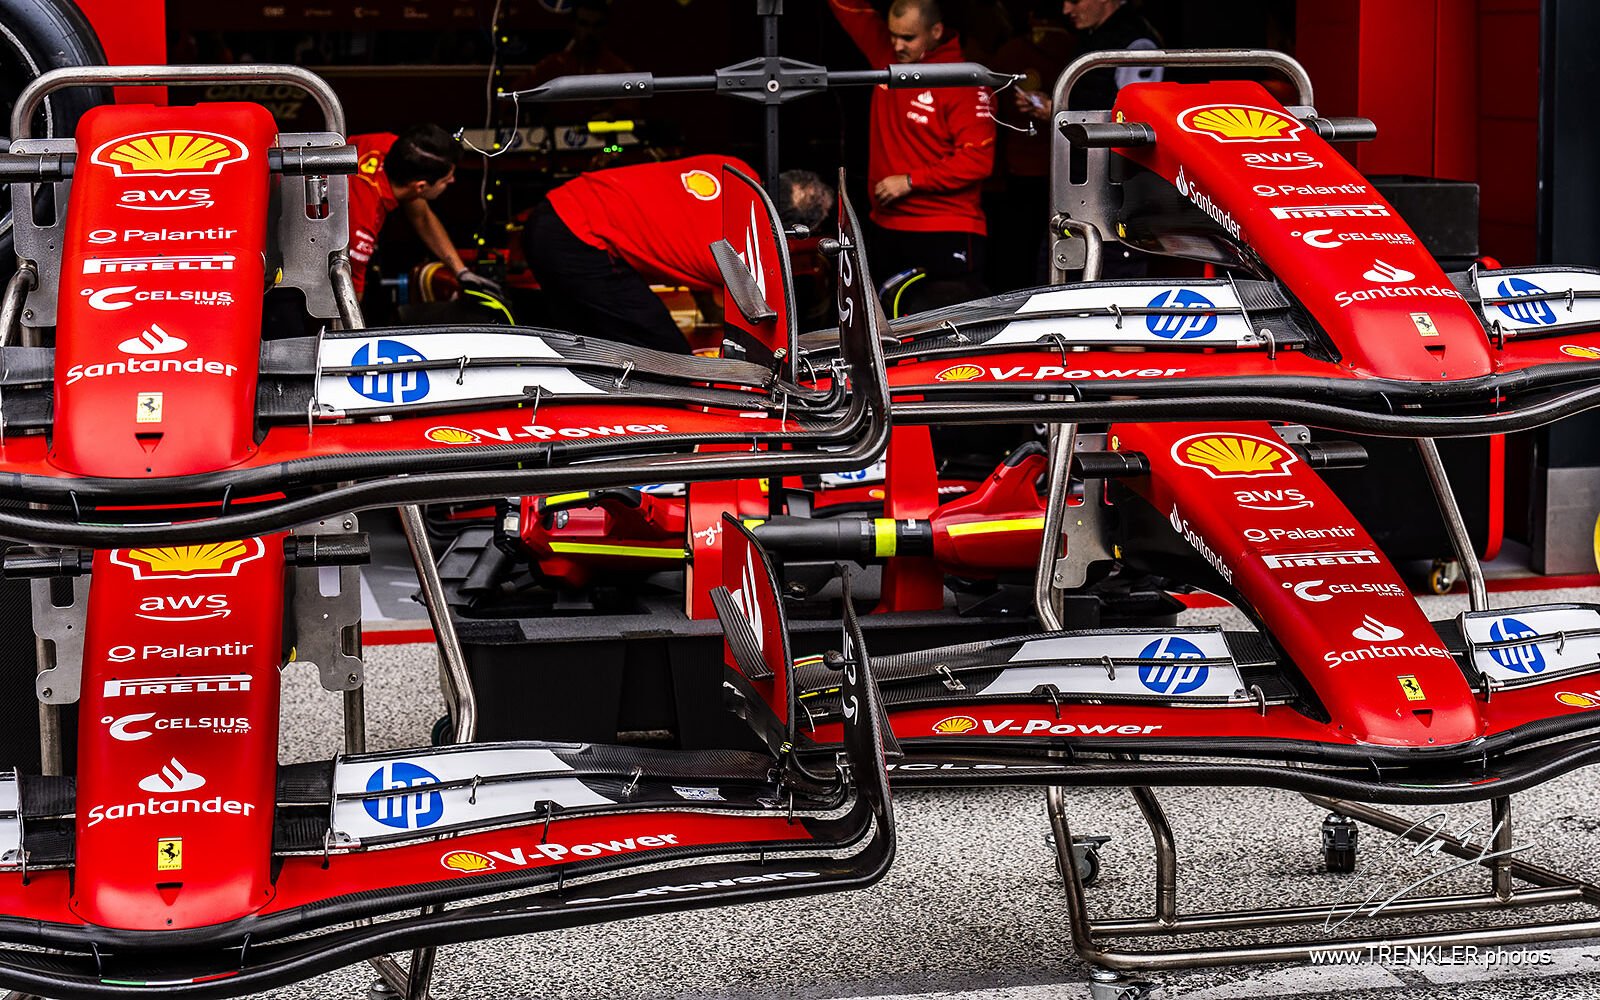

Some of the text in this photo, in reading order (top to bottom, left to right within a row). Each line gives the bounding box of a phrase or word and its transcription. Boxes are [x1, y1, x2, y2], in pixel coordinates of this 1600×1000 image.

[1242, 152, 1314, 164] aws
[120, 189, 212, 202] aws
[1283, 183, 1366, 195] Palantir
[1189, 181, 1241, 241] Santander
[1269, 203, 1391, 220] PIRELLI
[124, 227, 237, 241] Palantir
[1337, 232, 1413, 241] CELSIUS
[83, 255, 236, 275] PIRELLI
[135, 290, 231, 301] CELSIUS
[1335, 284, 1462, 308] Santander
[1503, 278, 1547, 325] hp
[1153, 289, 1211, 339] hp
[66, 357, 238, 386] Santander
[362, 340, 422, 403] hp
[989, 366, 1186, 381] V-Power
[475, 422, 669, 442] V-Power
[1234, 488, 1306, 502] aws
[1269, 526, 1356, 541] Palantir
[1183, 519, 1232, 585] Santander
[1262, 550, 1381, 570] PIRELLI
[1328, 583, 1402, 593] CELSIUS
[139, 594, 229, 610] aws
[142, 641, 254, 660] Palantir
[1324, 643, 1450, 668] Santander
[1496, 618, 1536, 673] hp
[1145, 636, 1202, 694] hp
[103, 674, 253, 697] PIRELLI
[155, 717, 250, 729] CELSIUS
[982, 719, 1163, 735] V-Power
[378, 763, 436, 829] hp
[88, 796, 255, 827] Santander
[490, 831, 679, 866] V-Power
